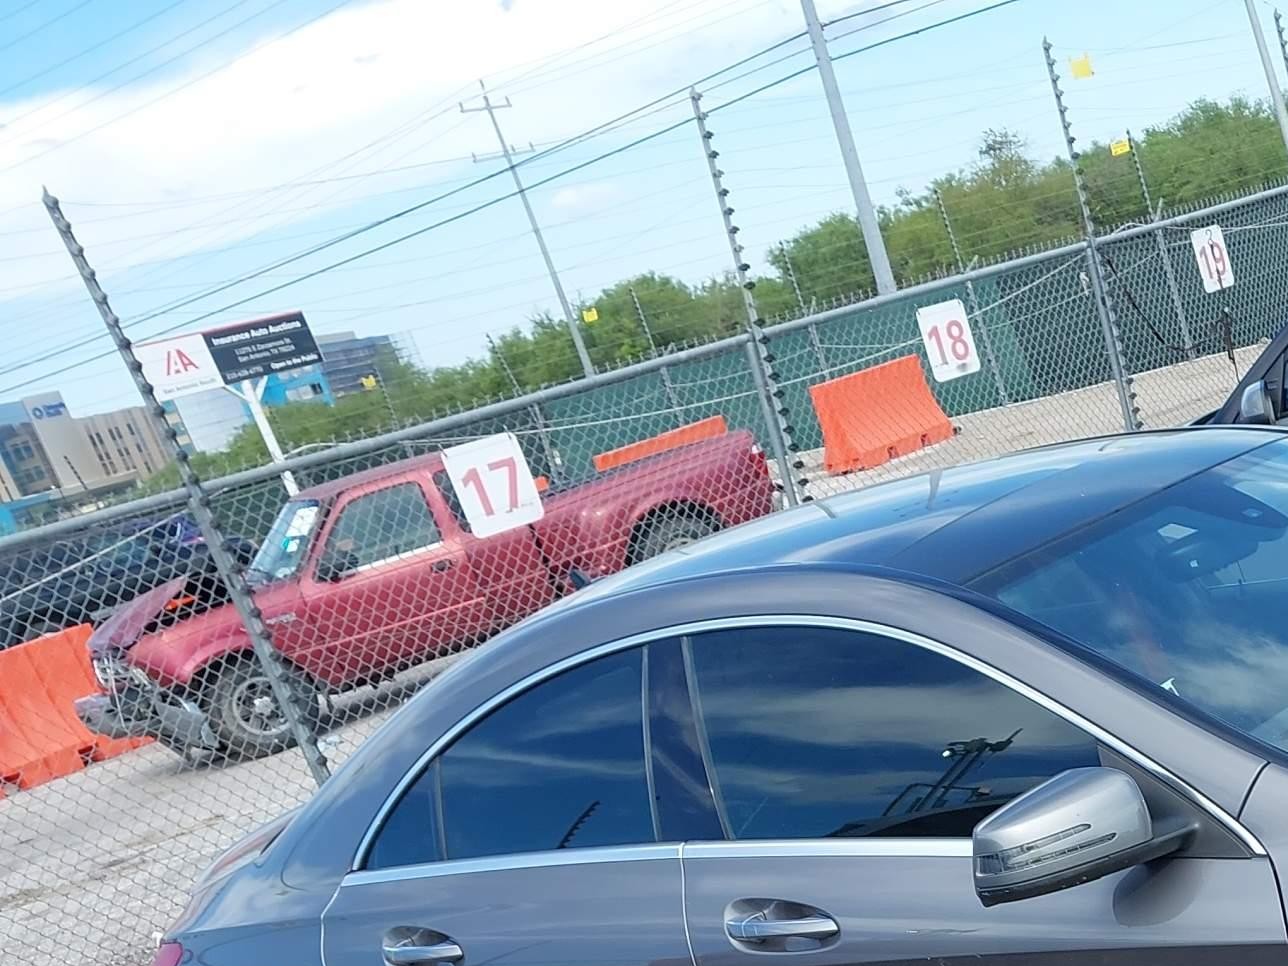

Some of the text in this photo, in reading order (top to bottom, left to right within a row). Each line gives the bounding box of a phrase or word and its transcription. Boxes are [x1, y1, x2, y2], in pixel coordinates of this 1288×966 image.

[1199, 241, 1227, 280] 19
[211, 320, 301, 346] Insurance Auto Auctions
[927, 319, 970, 365] 18
[461, 456, 519, 516] 17
